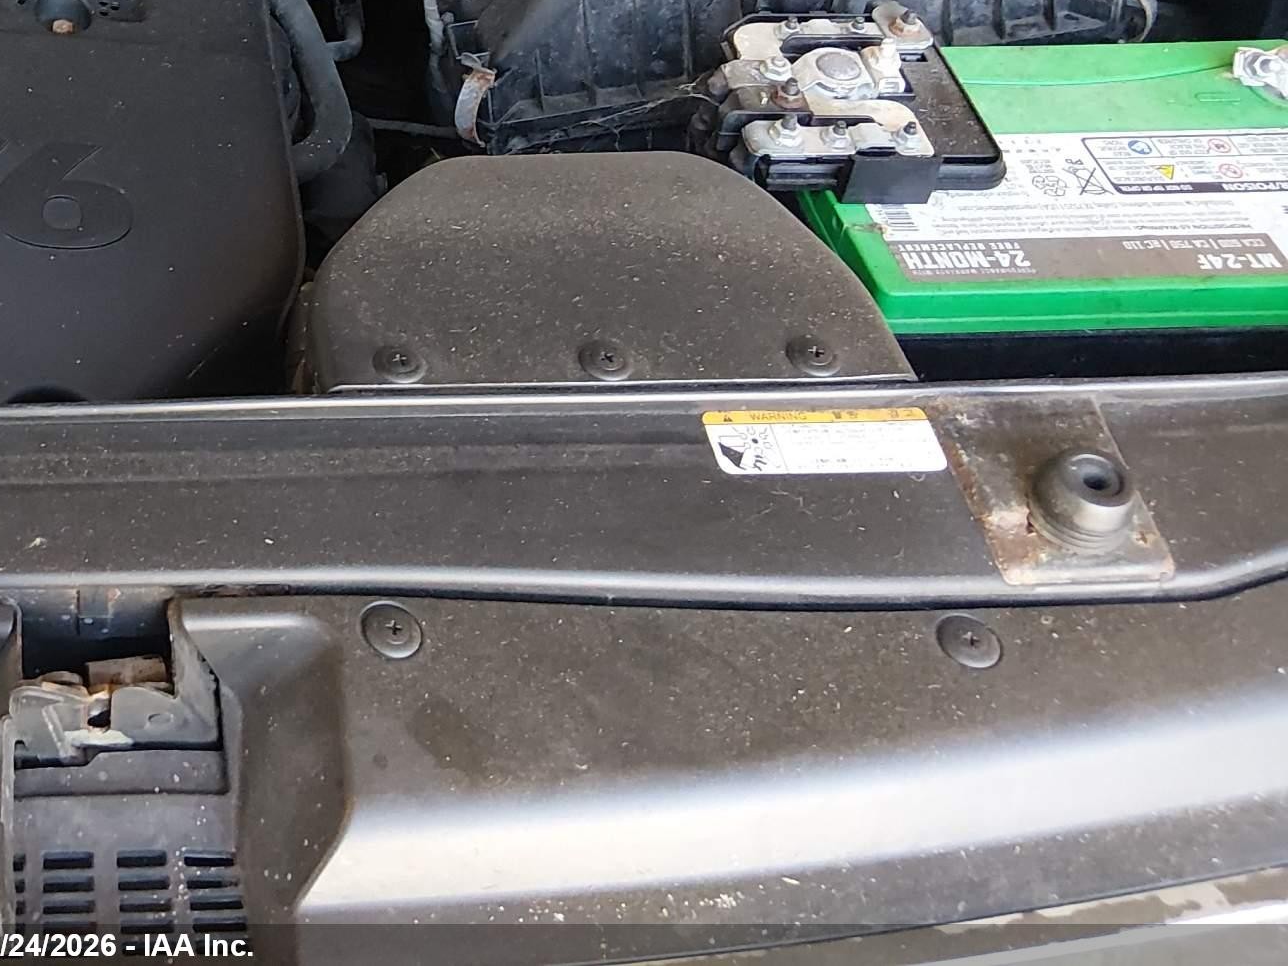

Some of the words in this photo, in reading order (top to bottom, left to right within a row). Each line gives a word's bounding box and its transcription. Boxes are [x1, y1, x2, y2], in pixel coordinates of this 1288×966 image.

[898, 242, 986, 252] REPLACEMENT
[989, 241, 1021, 250] FREE
[901, 250, 1032, 270] 24-MONTH
[749, 411, 808, 421] WARNING
